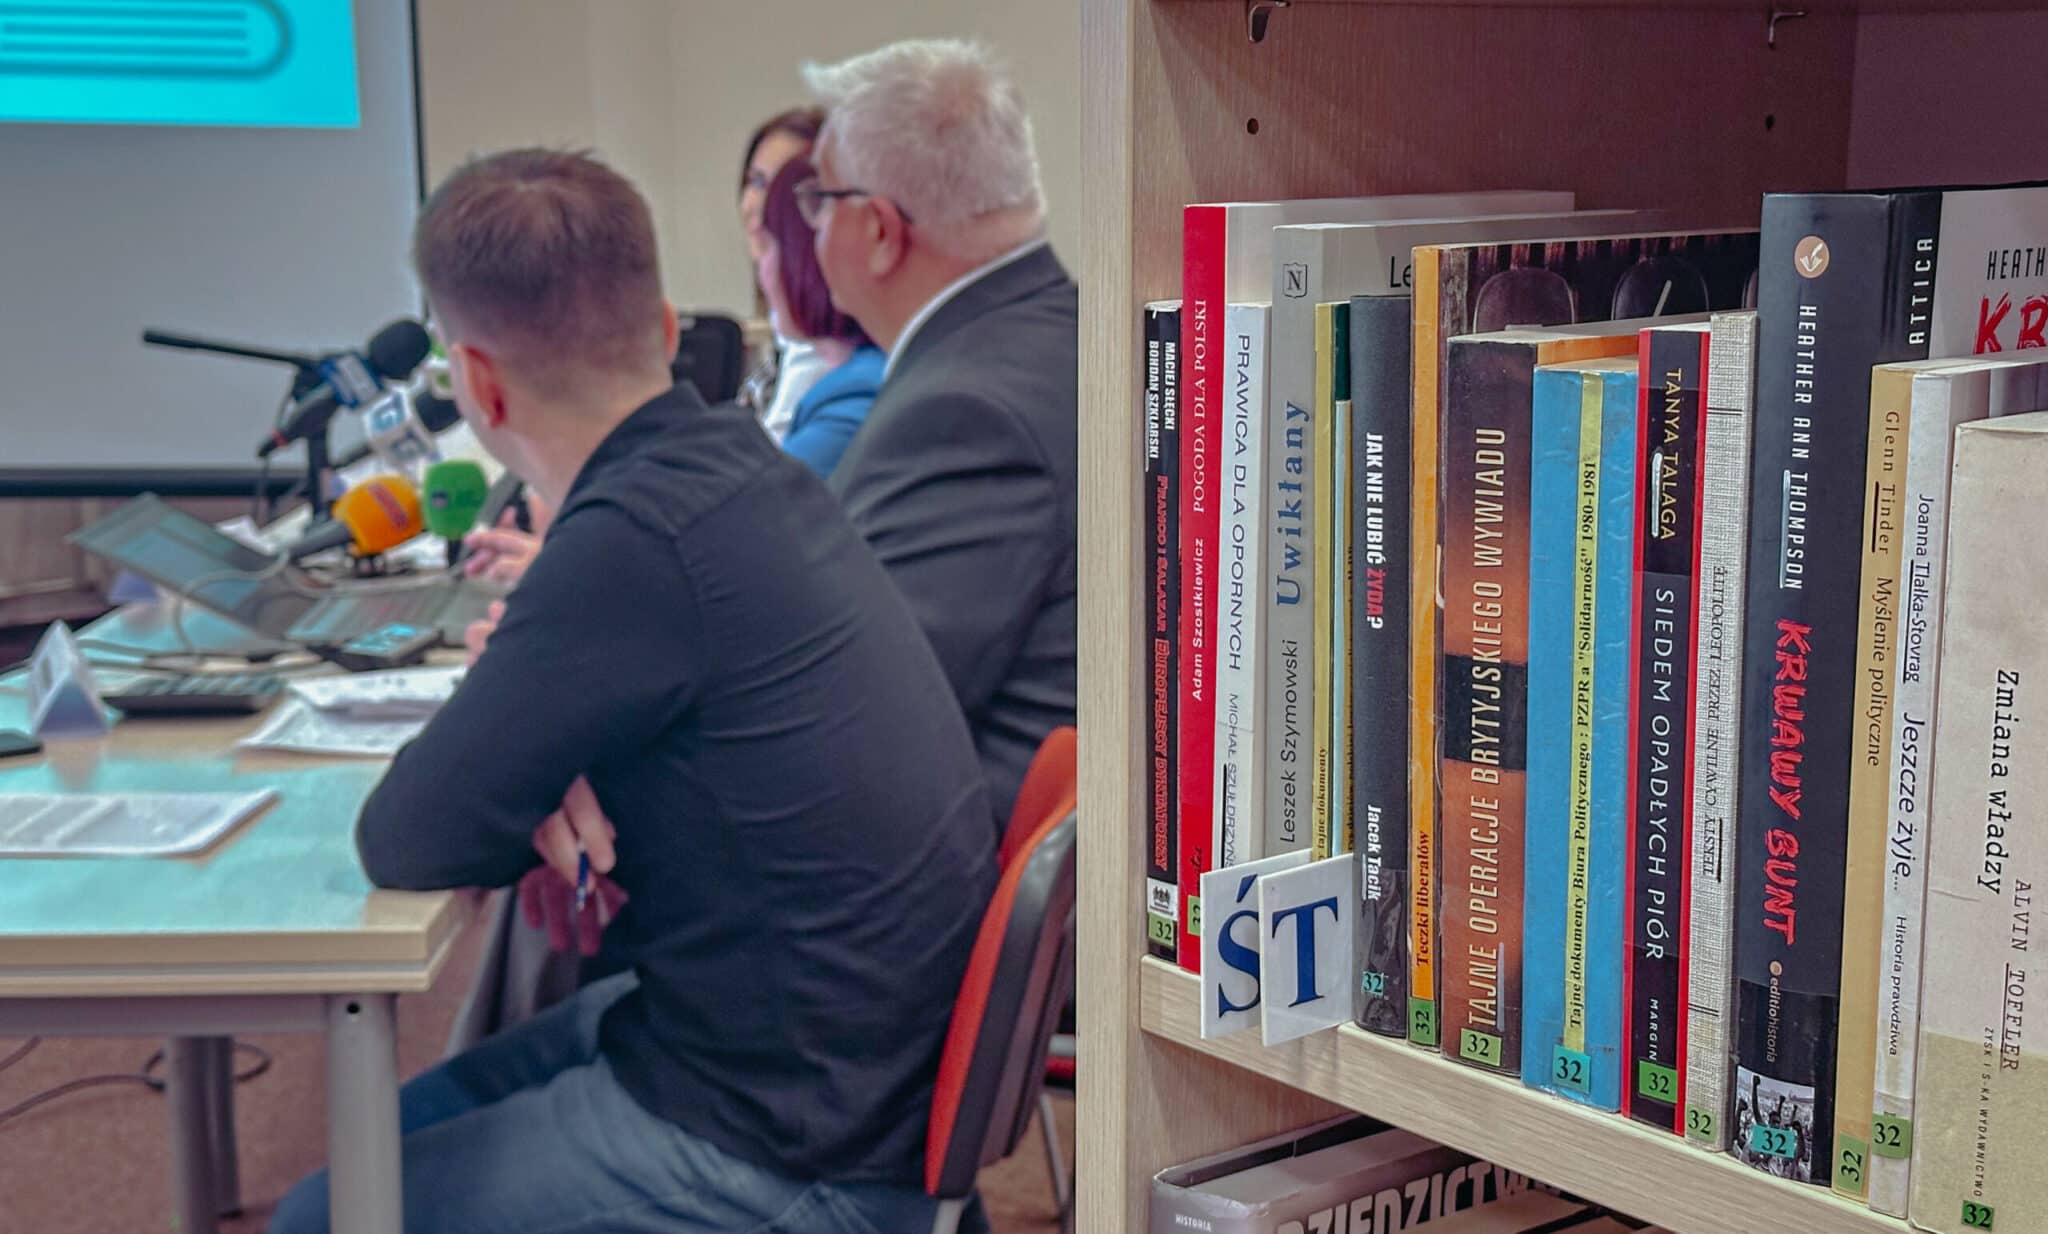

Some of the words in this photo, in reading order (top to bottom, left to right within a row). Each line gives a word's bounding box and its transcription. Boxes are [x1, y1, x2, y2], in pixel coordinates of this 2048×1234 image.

[1908, 237, 1933, 345] ATTICA
[1986, 247, 2048, 281] HEATH
[1149, 340, 1159, 391] BOHDAN
[1165, 342, 1176, 386] MACIEJ
[1194, 300, 1207, 371] POLSKI
[1794, 305, 1817, 404] HEATHER
[1149, 393, 1159, 459] SZKLARSKI
[1164, 388, 1176, 430] SŁĘCKI
[1194, 379, 1206, 419] DLA
[1235, 335, 1250, 456] PRAWICA
[1663, 368, 1682, 443] TANYA
[1193, 425, 1206, 513] POGODA
[1366, 432, 1383, 468] JAK
[1791, 416, 1811, 460] ANN
[1882, 410, 1900, 472] Glenn
[1232, 464, 1246, 515] DLA
[1277, 401, 1309, 606] Uwikłany
[1366, 472, 1383, 503] NIE
[1474, 428, 1505, 568] WYWIADU
[1582, 462, 1596, 541] 1980-1981
[1661, 452, 1679, 540] TALAGA
[1879, 484, 1896, 554] Tinder
[1366, 507, 1386, 564] LUBIĆ
[1784, 472, 1808, 590] THOMPSON
[1915, 493, 1935, 556] Joanna
[1193, 538, 1204, 648] Szostkiewicz
[1229, 524, 1245, 670] OPORNYCH
[1366, 567, 1386, 630] ŻYDA?
[1710, 565, 1728, 661] LEOPOLITĘ
[1872, 577, 1893, 662] Myślenie
[1192, 653, 1203, 701] Adam
[1581, 667, 1590, 676] a
[1652, 588, 1674, 702] SIEDEM
[1281, 639, 1300, 763] Szymowski
[1471, 580, 1503, 785] BRYTYJSKIEGO
[1577, 679, 1590, 727] PZPR
[1708, 669, 1721, 720] PRZEZ
[1226, 693, 1239, 759] MICHAŁ
[1768, 619, 1814, 820] KRWAWY
[1866, 669, 1888, 767] polityczne
[1991, 669, 2019, 778] Zmiana
[1317, 746, 1327, 815] dokumenty
[1574, 743, 1591, 841] Politycznego
[1647, 715, 1670, 876] OPADŁYCH
[1704, 728, 1719, 806] CYWILNE
[1899, 712, 1926, 813] Jeszcze
[1280, 771, 1296, 843] Leszek
[1367, 804, 1383, 854] Jacek
[1416, 831, 1430, 910] liberałów
[1469, 795, 1499, 934] OPERACJE
[1573, 846, 1586, 890] Biura
[1703, 815, 1716, 875] TEKSTY
[1977, 790, 2012, 895] władzy
[1367, 856, 1382, 901] Tacik
[1763, 828, 1800, 945] BUNT
[1156, 920, 1172, 941] 32
[1416, 912, 1430, 966] Teczki
[1570, 894, 1587, 983] dokumenty
[1645, 888, 1669, 960] PIÓR
[1893, 916, 1907, 972] Historia
[2011, 879, 2032, 952] ALVIN
[1272, 896, 1338, 1008] T
[1363, 972, 1383, 993] 32
[1468, 943, 1497, 1026] TAJNE
[1415, 1009, 1430, 1034] 32
[1570, 983, 1584, 1028] Tajne
[1648, 998, 1659, 1061] MARGIN
[1766, 974, 1782, 1063] editiohistoria
[1888, 974, 1901, 1057] prawdziwa
[2002, 970, 2025, 1071] TOFFLER
[1467, 1033, 1489, 1057] 32
[1556, 1056, 1582, 1084] 32
[1984, 1026, 1994, 1058] ZYSK
[1648, 1072, 1670, 1095] 32
[1980, 1073, 1991, 1102] S-KA
[1687, 1108, 1712, 1135] 32
[1761, 1129, 1788, 1155] 32
[1874, 1122, 1901, 1147] 32
[1973, 1109, 1989, 1197] WYDAWNICTWO
[1841, 1151, 1862, 1183] 32
[1175, 1213, 1212, 1233] HISTORIA
[1964, 1204, 1991, 1228] 32
